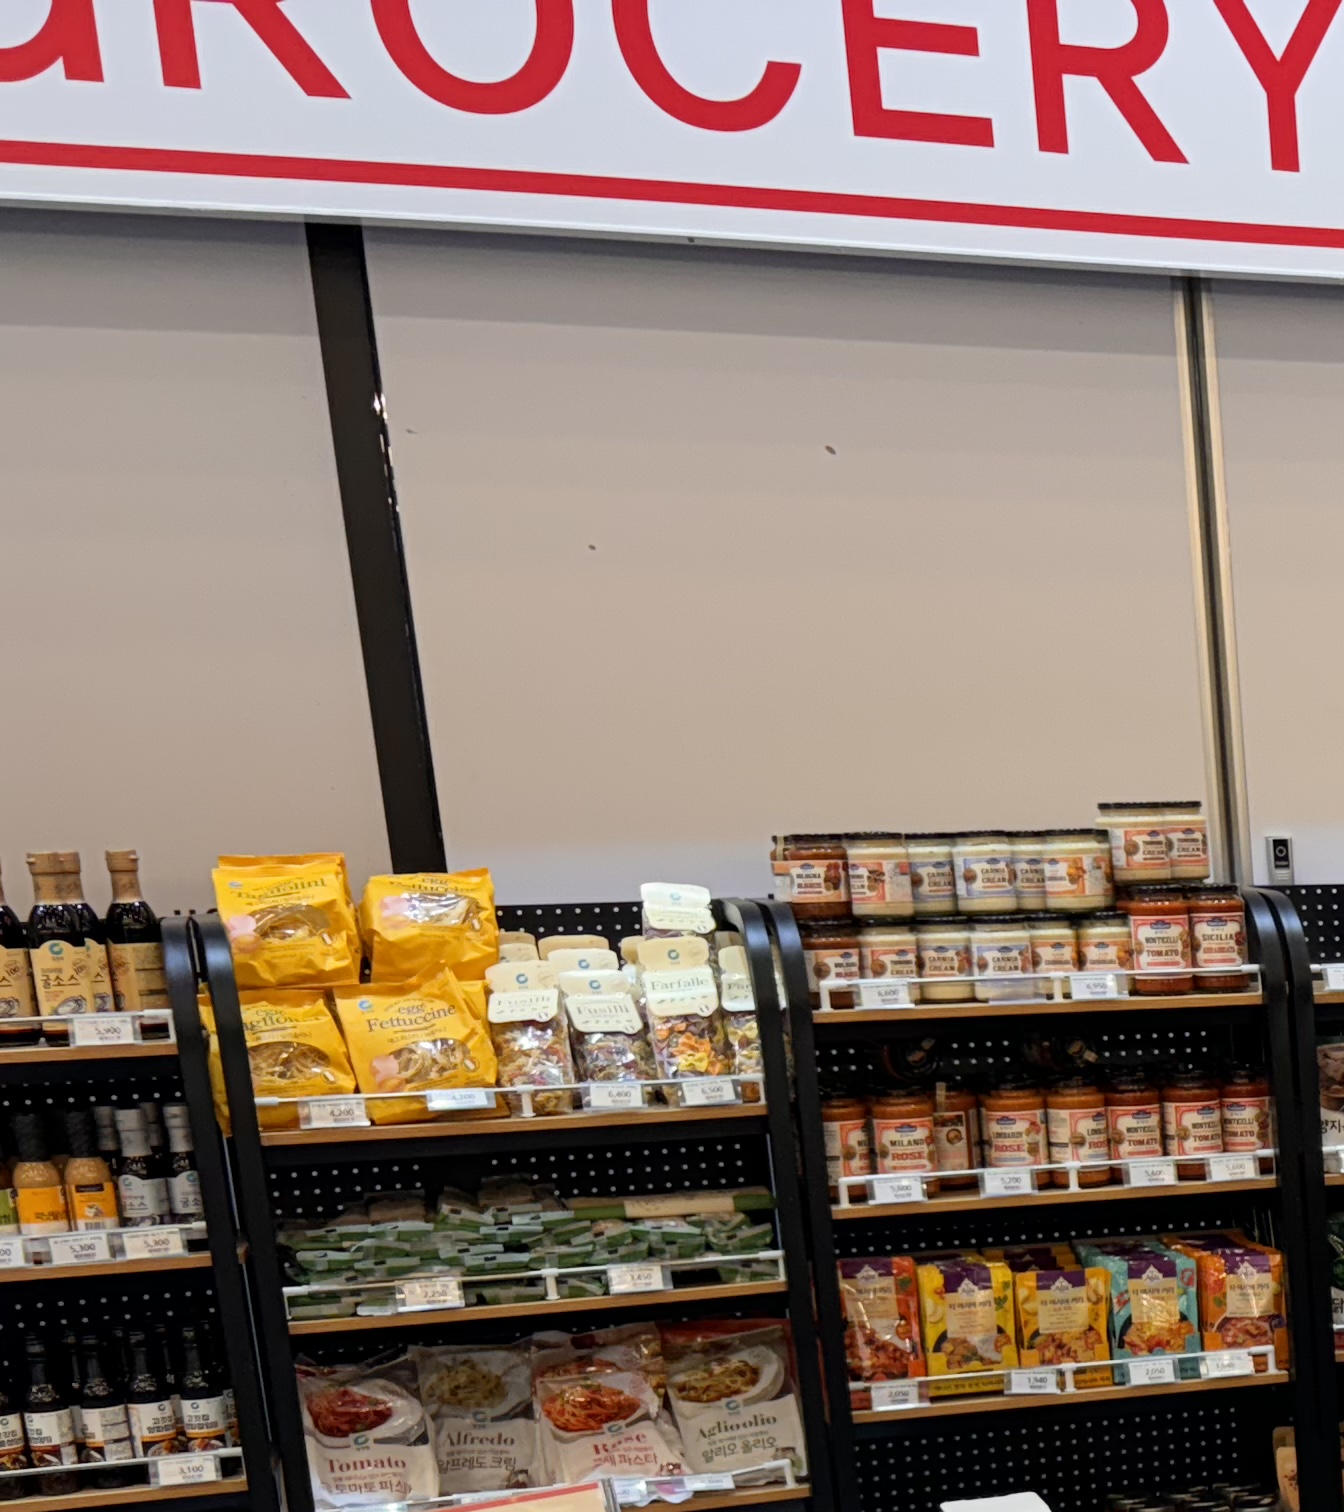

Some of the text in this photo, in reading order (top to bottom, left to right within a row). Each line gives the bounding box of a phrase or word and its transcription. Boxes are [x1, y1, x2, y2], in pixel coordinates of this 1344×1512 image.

[1146, 950, 1179, 958] TOMATO
[41, 974, 80, 989] 굴소스
[651, 978, 709, 991] Farfalle
[367, 1004, 456, 1032] Fettuccine
[445, 1431, 515, 1447] Alfredo
[702, 1436, 776, 1463] 알리오 올리오
[328, 1456, 407, 1474] Tomato
[618, 1454, 658, 1467] 파스타
